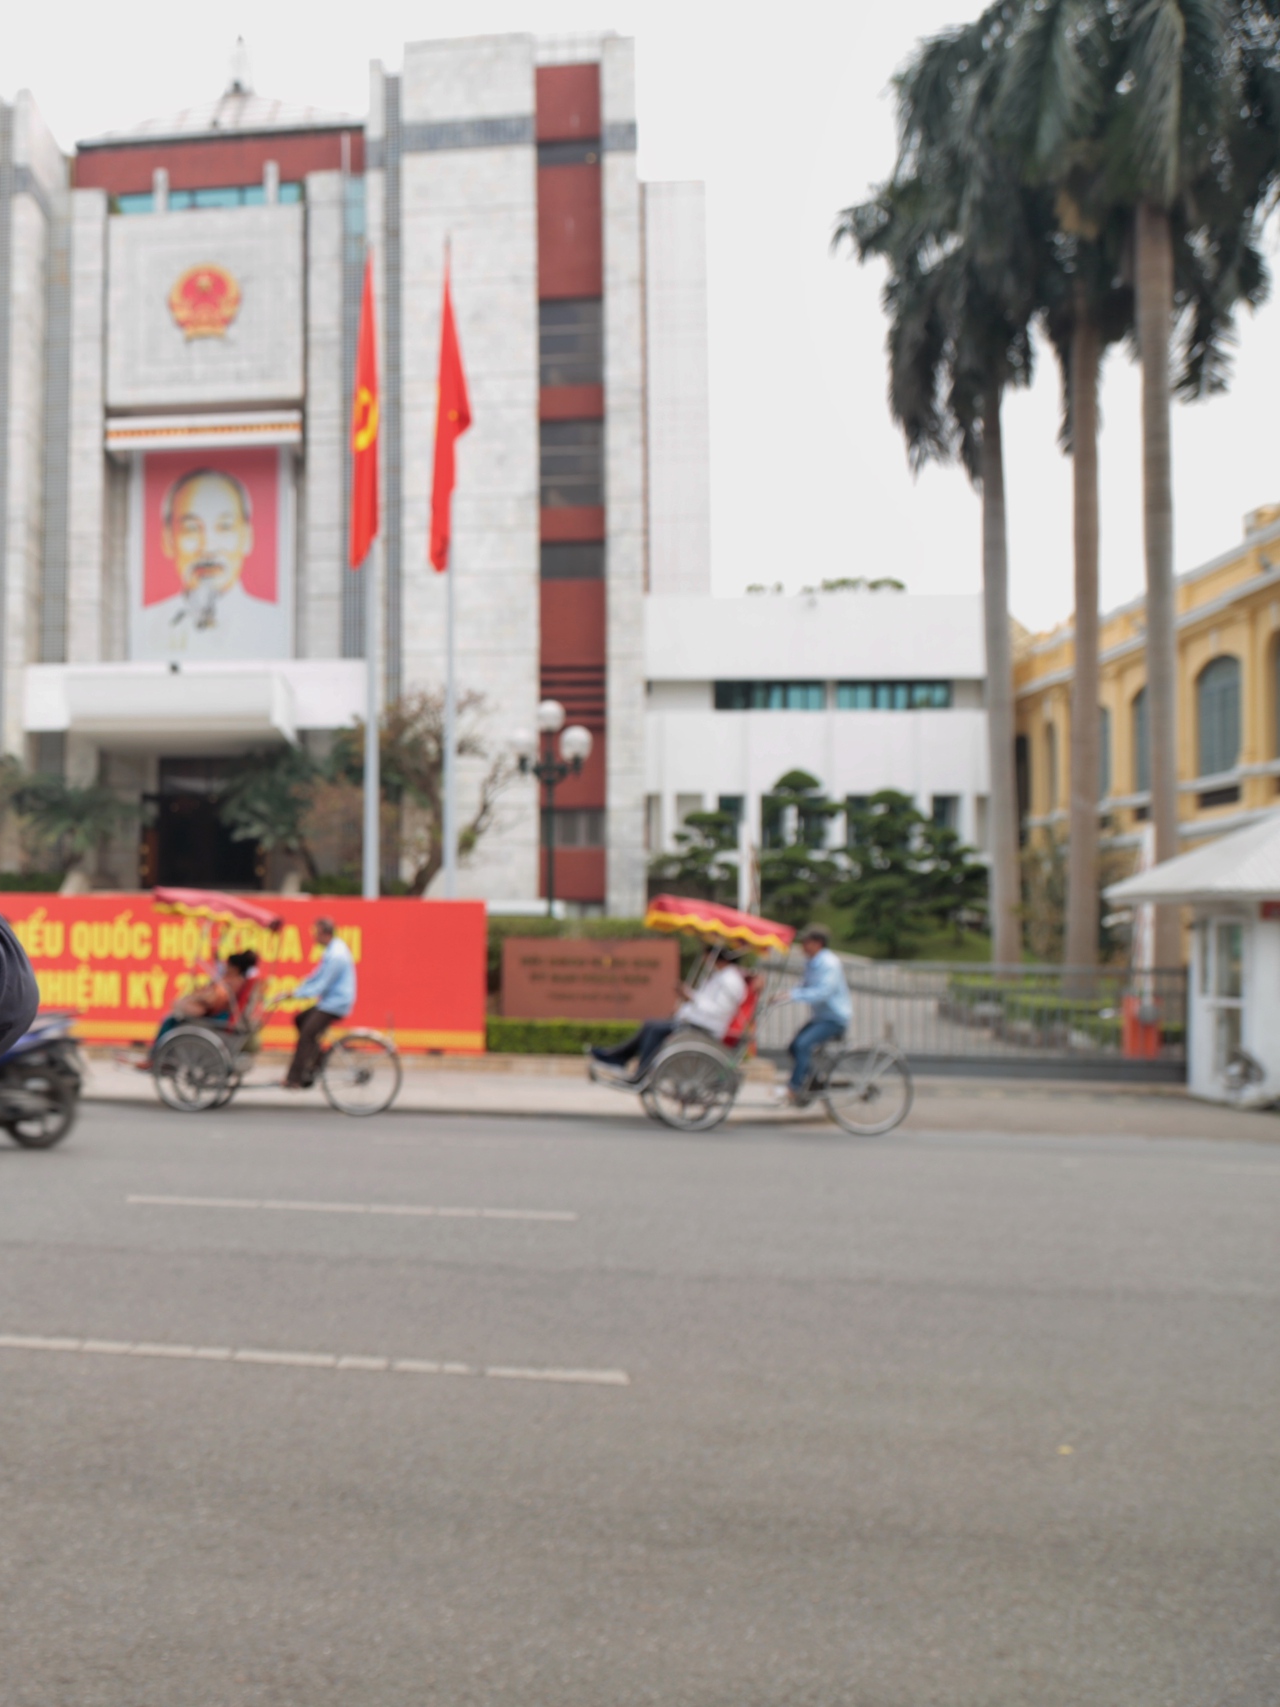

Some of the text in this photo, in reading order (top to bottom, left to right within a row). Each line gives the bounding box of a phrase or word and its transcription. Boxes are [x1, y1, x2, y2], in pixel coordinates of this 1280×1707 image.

[11, 907, 65, 957] IỂU
[71, 909, 152, 962] QUỐC
[158, 915, 211, 968] HỘI
[127, 964, 169, 1009] KỲ
